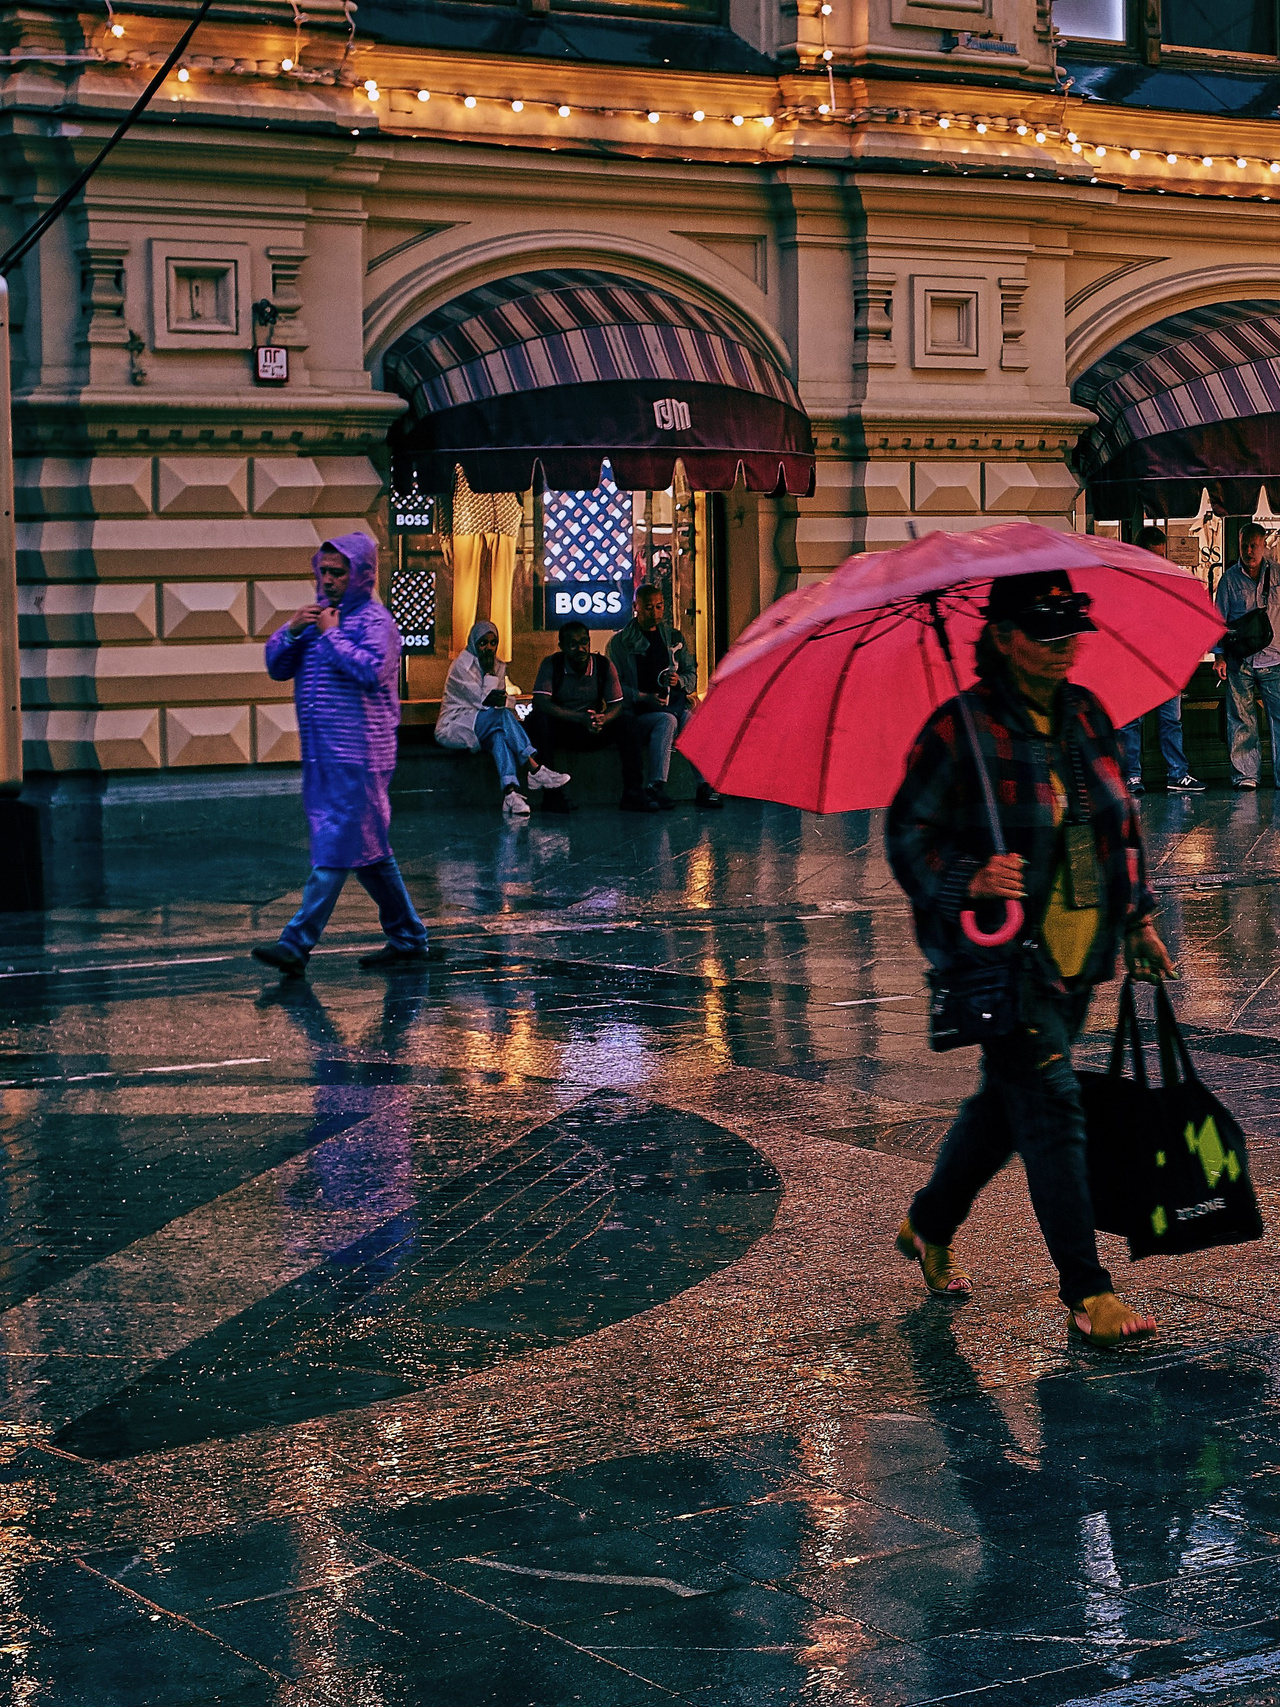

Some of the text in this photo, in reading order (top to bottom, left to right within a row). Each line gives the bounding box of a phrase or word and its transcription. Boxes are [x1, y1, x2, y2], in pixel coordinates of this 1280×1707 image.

[264, 349, 281, 364] ПГ
[396, 513, 430, 526] BOSS
[555, 590, 622, 615] BOSS
